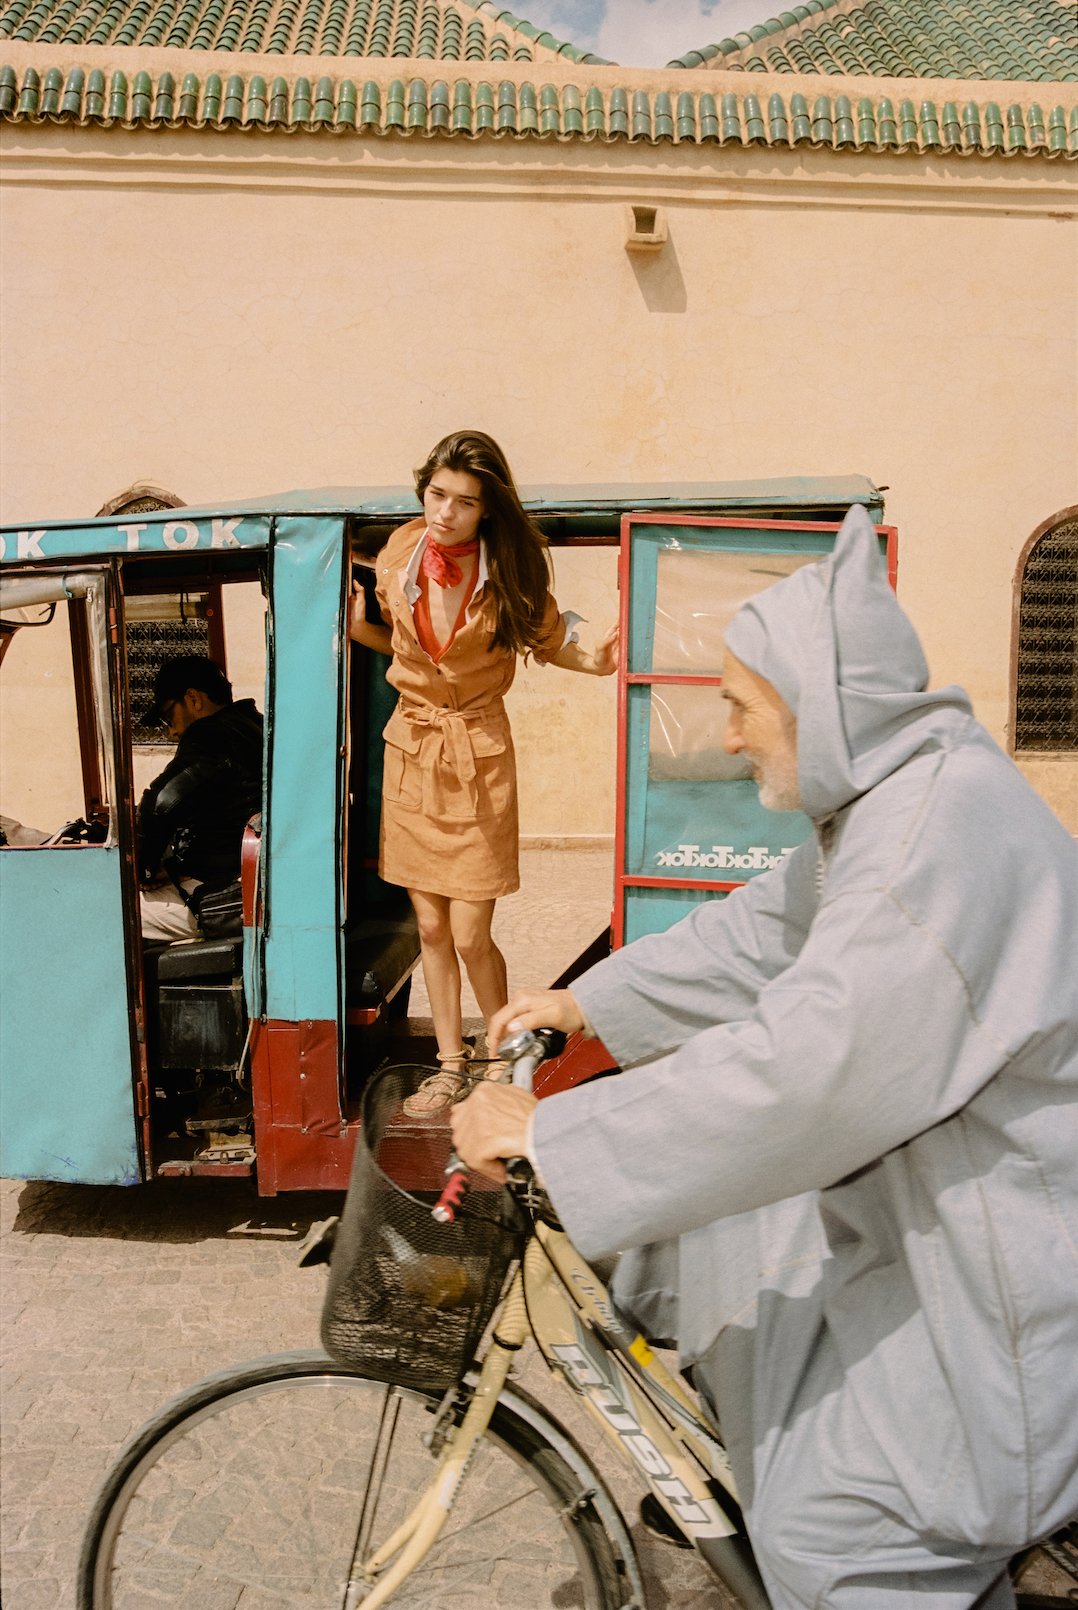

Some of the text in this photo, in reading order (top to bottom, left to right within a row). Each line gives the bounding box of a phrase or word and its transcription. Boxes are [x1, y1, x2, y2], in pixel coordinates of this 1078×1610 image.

[0, 517, 245, 560] K TOK
[550, 1343, 712, 1523] RUSH
